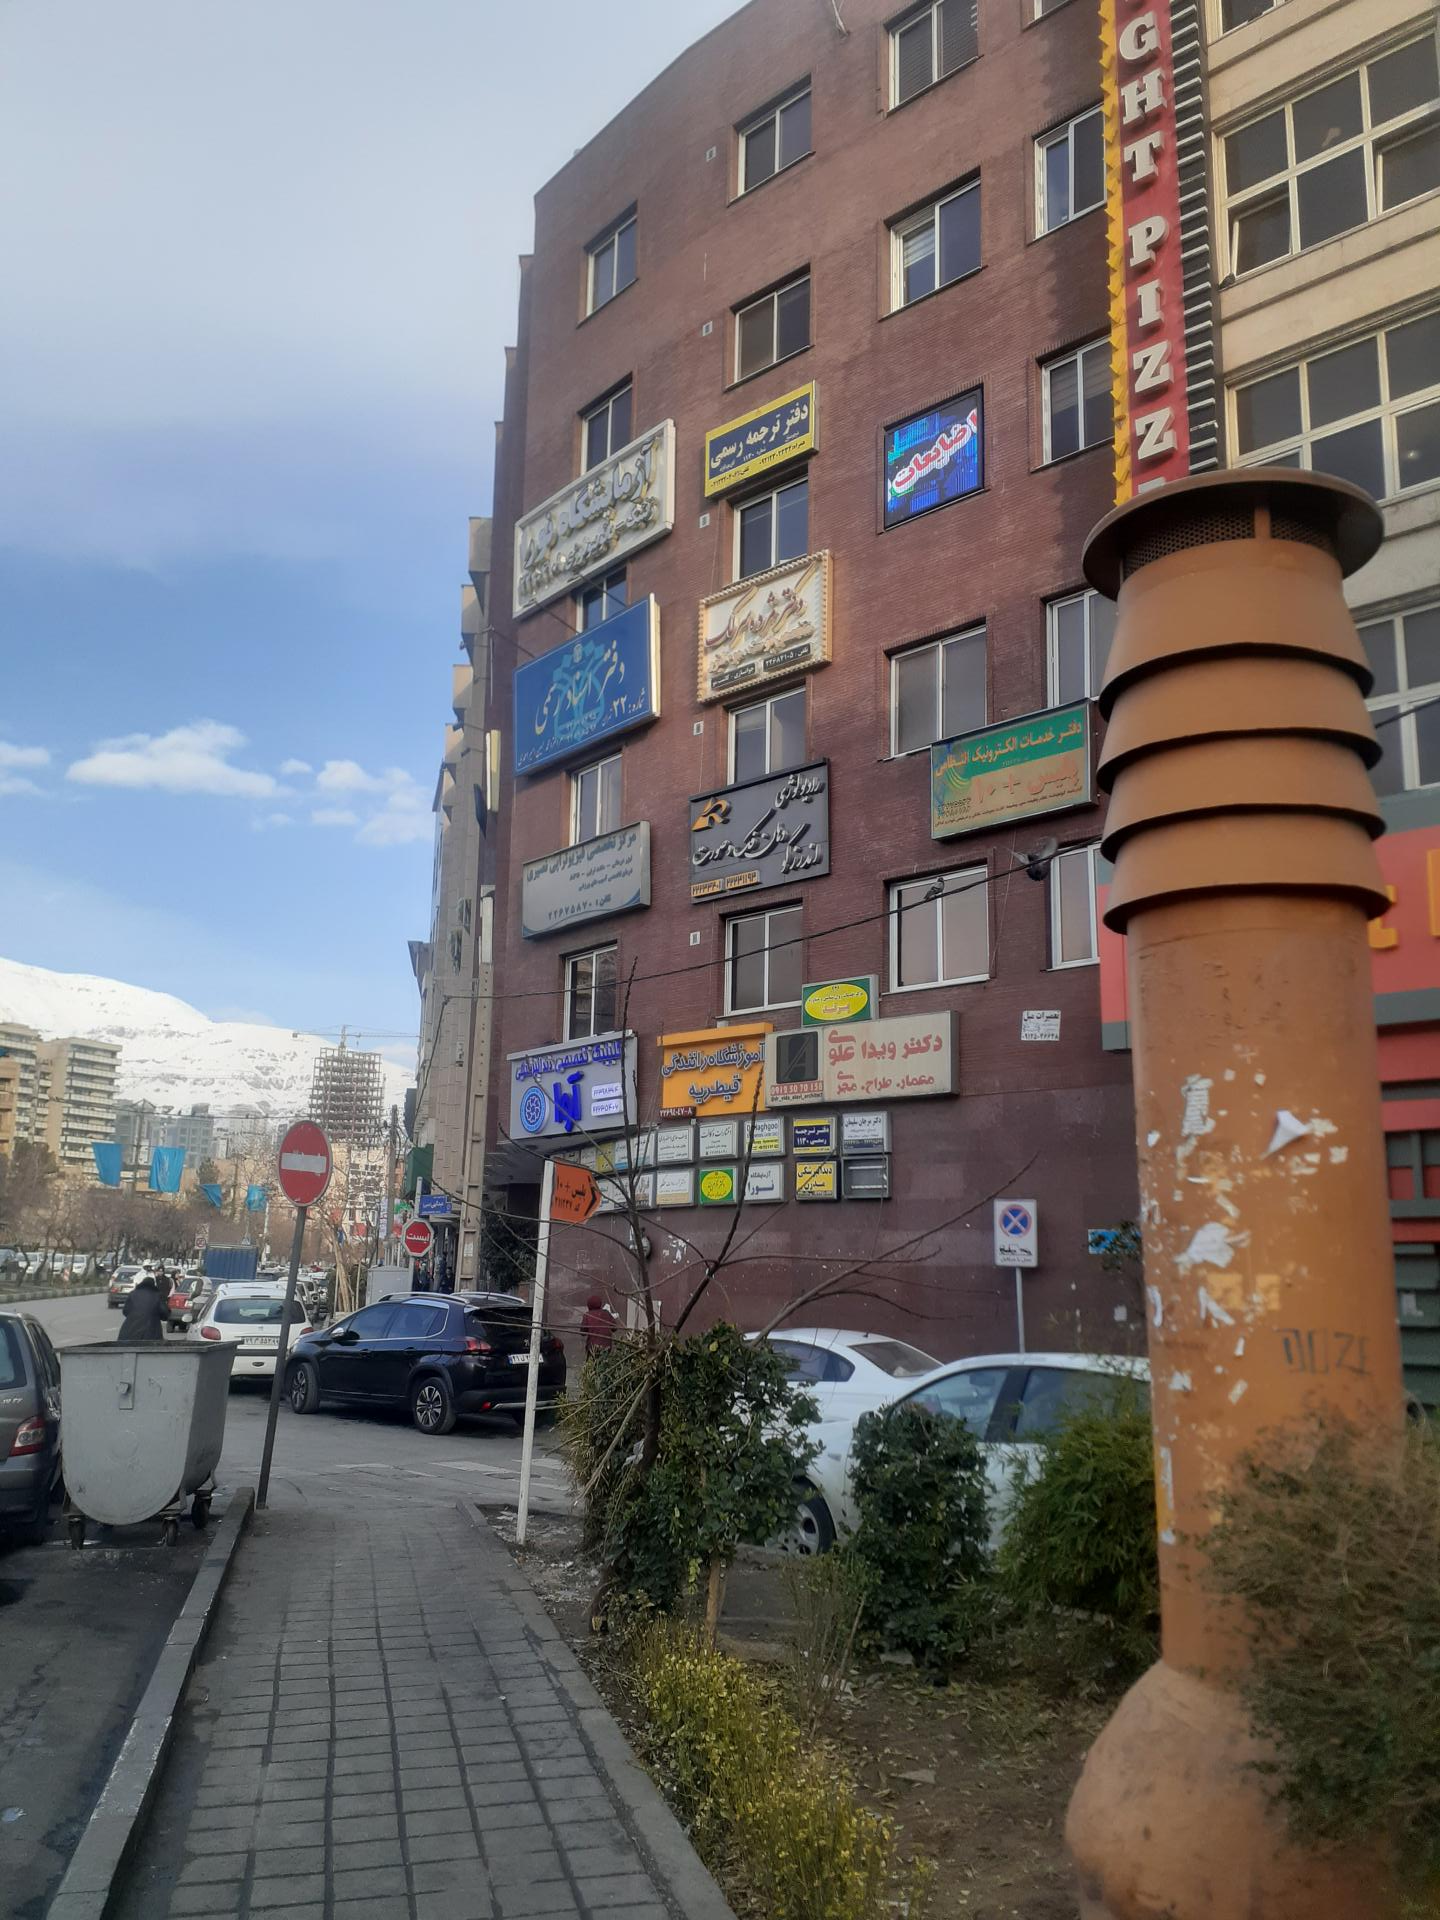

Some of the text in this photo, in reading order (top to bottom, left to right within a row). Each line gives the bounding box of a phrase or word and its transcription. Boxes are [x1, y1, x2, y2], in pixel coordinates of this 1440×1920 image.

[1127, 215, 1177, 493] PIZZ
[746, 414, 781, 444] ترجمه
[783, 402, 809, 436] دفتر
[711, 439, 744, 469] رسمی
[557, 434, 662, 538] آزمایشگاه
[519, 512, 558, 570] نورا
[535, 640, 625, 735] دفتر اسناد رسمی
[1019, 729, 1055, 749] خدمات
[1058, 719, 1082, 744] دفتر
[972, 737, 1017, 763] الکترونیک
[775, 774, 821, 808] رادیولوژی
[662, 1042, 766, 1077] آموزشگاه رانندگی
[828, 1029, 943, 1067] دکتر ویدا علوی
[688, 1073, 741, 1104] قیطریه
[406, 1231, 430, 1245] ایست
